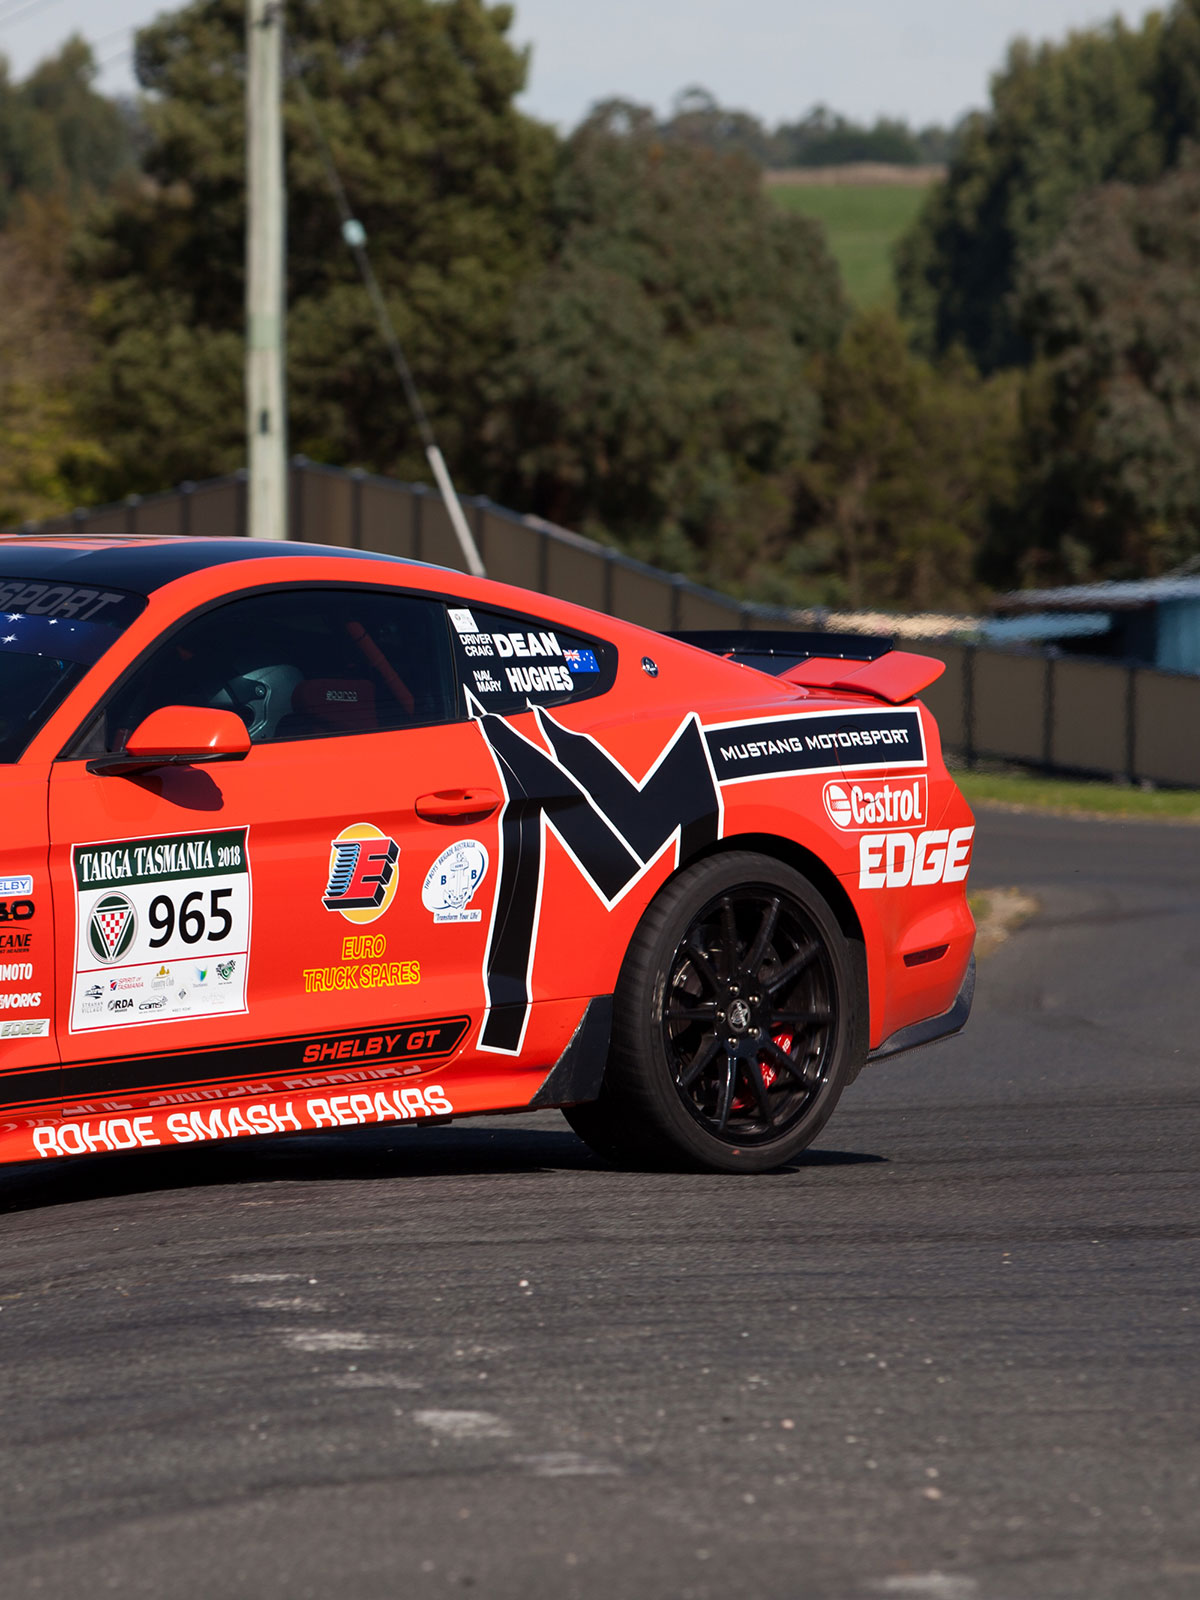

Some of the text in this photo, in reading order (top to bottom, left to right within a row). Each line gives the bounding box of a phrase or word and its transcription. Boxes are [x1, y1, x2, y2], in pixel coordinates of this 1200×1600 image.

[459, 632, 562, 657] DRIVER DEAN
[464, 646, 494, 657] CRAIG
[476, 681, 501, 692] MARY
[505, 666, 574, 692] HUGHES
[720, 728, 909, 761] MUSTANG MOTORSPORT
[850, 781, 922, 825] Castrol
[80, 840, 240, 882] TARGA TASMANIA 2018
[858, 825, 975, 889] EDGE
[149, 888, 233, 948] 965
[342, 934, 387, 960] EURO
[303, 961, 420, 992] TRUCK SPARES
[138, 1002, 163, 1011] cams
[1, 1020, 46, 1037] EDGE
[302, 1030, 441, 1063] SHELBY GT
[32, 1115, 161, 1158] ROHDE
[166, 1100, 303, 1144] SMASH
[306, 1085, 453, 1129] REPAIRS
